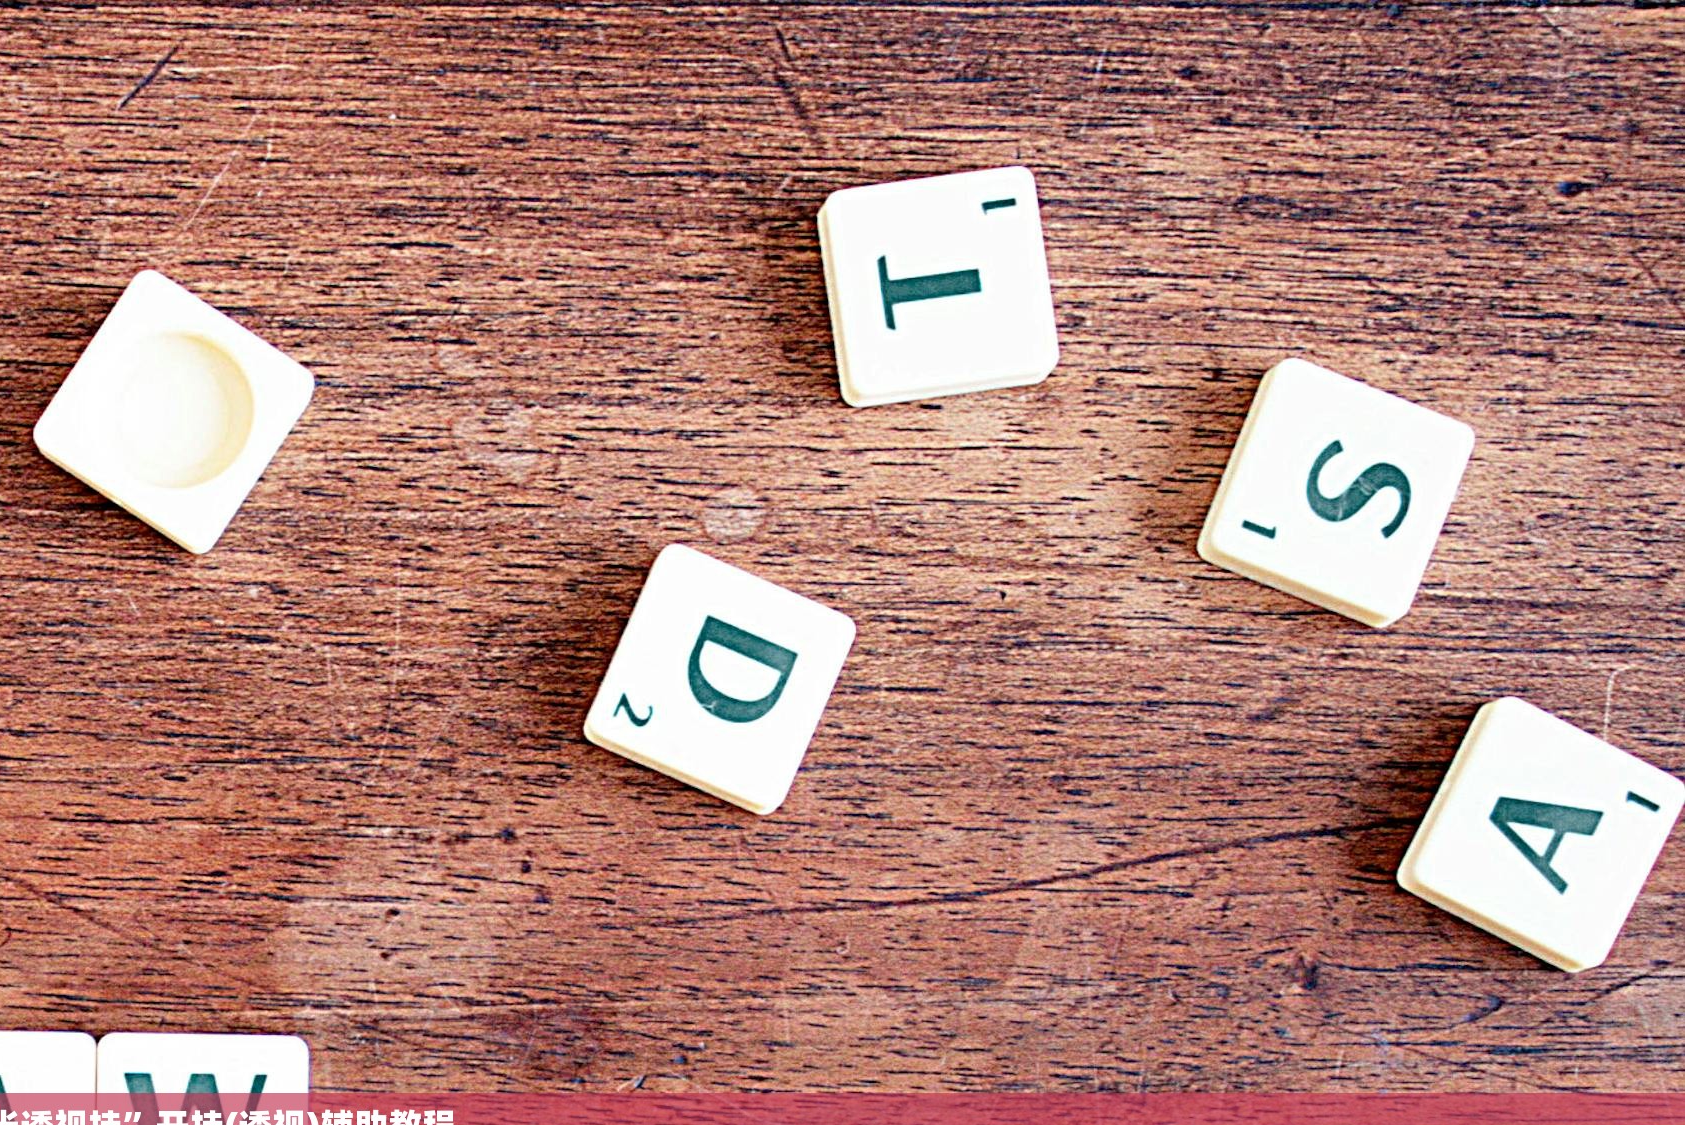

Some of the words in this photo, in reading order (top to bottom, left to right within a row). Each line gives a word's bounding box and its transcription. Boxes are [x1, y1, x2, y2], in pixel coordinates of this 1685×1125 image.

[980, 196, 1018, 215] 1
[877, 255, 982, 331] T
[1306, 440, 1412, 539] S
[1240, 519, 1278, 540] 1
[687, 615, 798, 724] D
[612, 692, 654, 728] 2
[1625, 790, 1661, 813] 1
[1489, 796, 1604, 894] A
